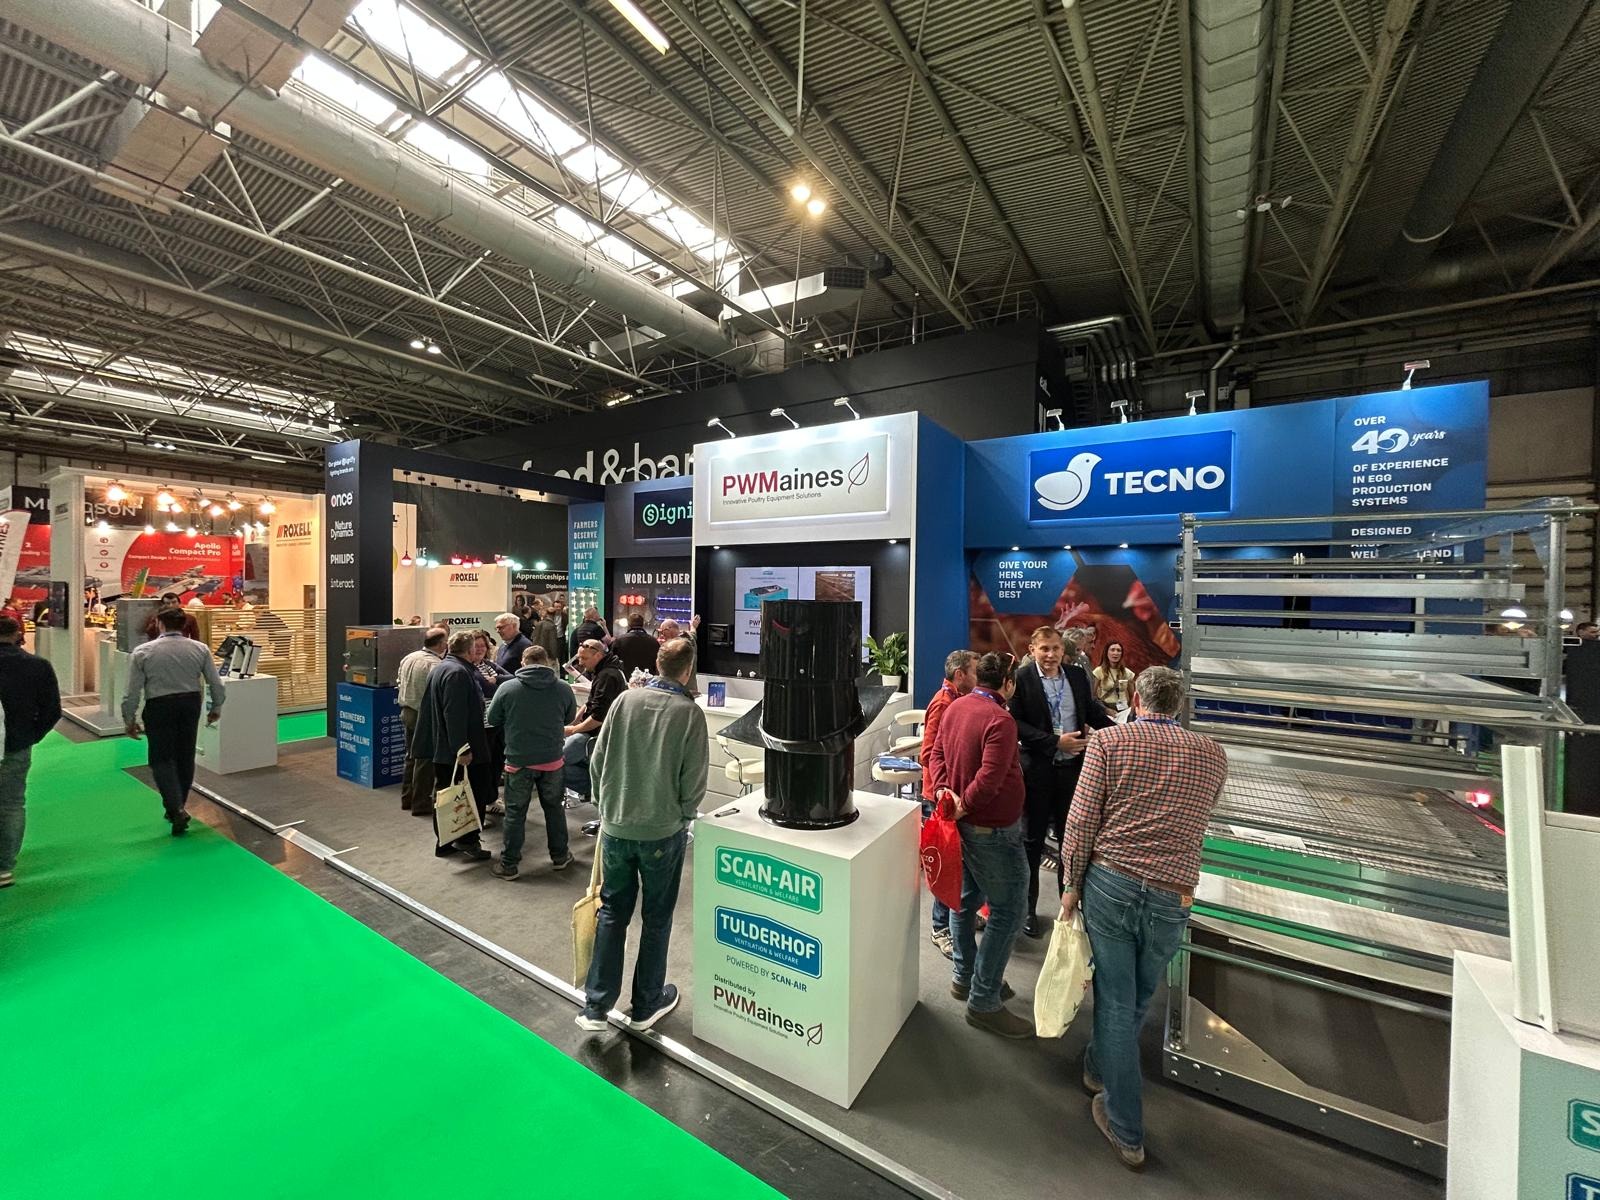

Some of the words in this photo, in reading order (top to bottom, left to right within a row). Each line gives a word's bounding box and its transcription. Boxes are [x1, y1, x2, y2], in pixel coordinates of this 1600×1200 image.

[1353, 415, 1386, 427] OVER
[1351, 427, 1410, 455] 40
[1409, 429, 1447, 447] years
[1352, 463, 1369, 473] OF
[1371, 457, 1449, 472] EXPERIENCE
[722, 467, 844, 497] PWMaines
[1104, 465, 1225, 495] TECNO
[1352, 475, 1366, 484] IN
[1367, 473, 1393, 483] EGG
[1352, 482, 1432, 496] PRODUCTION
[331, 492, 353, 507] once
[722, 497, 748, 506] Innovative
[747, 496, 766, 505] Poultry
[766, 493, 795, 503] Equipment
[795, 491, 822, 499] Solutions
[1351, 496, 1409, 507] SYSTEMS
[283, 521, 312, 538] ROXELL
[334, 520, 353, 530] Nature
[573, 520, 599, 530] FARMERS
[330, 528, 354, 541] Dynamics
[573, 531, 598, 540] DESERVE
[1351, 526, 1412, 537] DESIGNED
[194, 542, 222, 550] Apollo
[573, 541, 599, 550] LIGHTING
[169, 548, 206, 556] Compact
[573, 552, 593, 561] THAT'S
[330, 553, 355, 565] PHILIPS
[998, 561, 1021, 569] GIVE
[1022, 560, 1048, 569] YOUR
[573, 562, 589, 570] BUILT
[455, 572, 479, 582] ROXELL
[515, 573, 565, 582] Apprenticeships
[573, 572, 581, 580] TO
[624, 573, 653, 584] WORLD
[655, 573, 690, 584] LEADER
[998, 571, 1024, 579] HENS
[998, 580, 1017, 589] THE
[1018, 580, 1043, 589] VERY
[998, 590, 1021, 599] BEST
[448, 617, 480, 625] ROXELL
[720, 853, 816, 899] SCAN-AIR
[735, 879, 768, 893] VENTILATION
[774, 891, 799, 904] WELFARE
[720, 913, 816, 959] TULDERHOF
[734, 937, 768, 954] VENTILATION
[774, 951, 799, 965] WELFARE
[726, 954, 760, 975] POWERED
[760, 967, 771, 978] BY
[770, 972, 808, 993] SCAN-AIR
[714, 974, 747, 993] Distributed
[746, 988, 756, 997] by
[713, 985, 805, 1038] PWMaines
